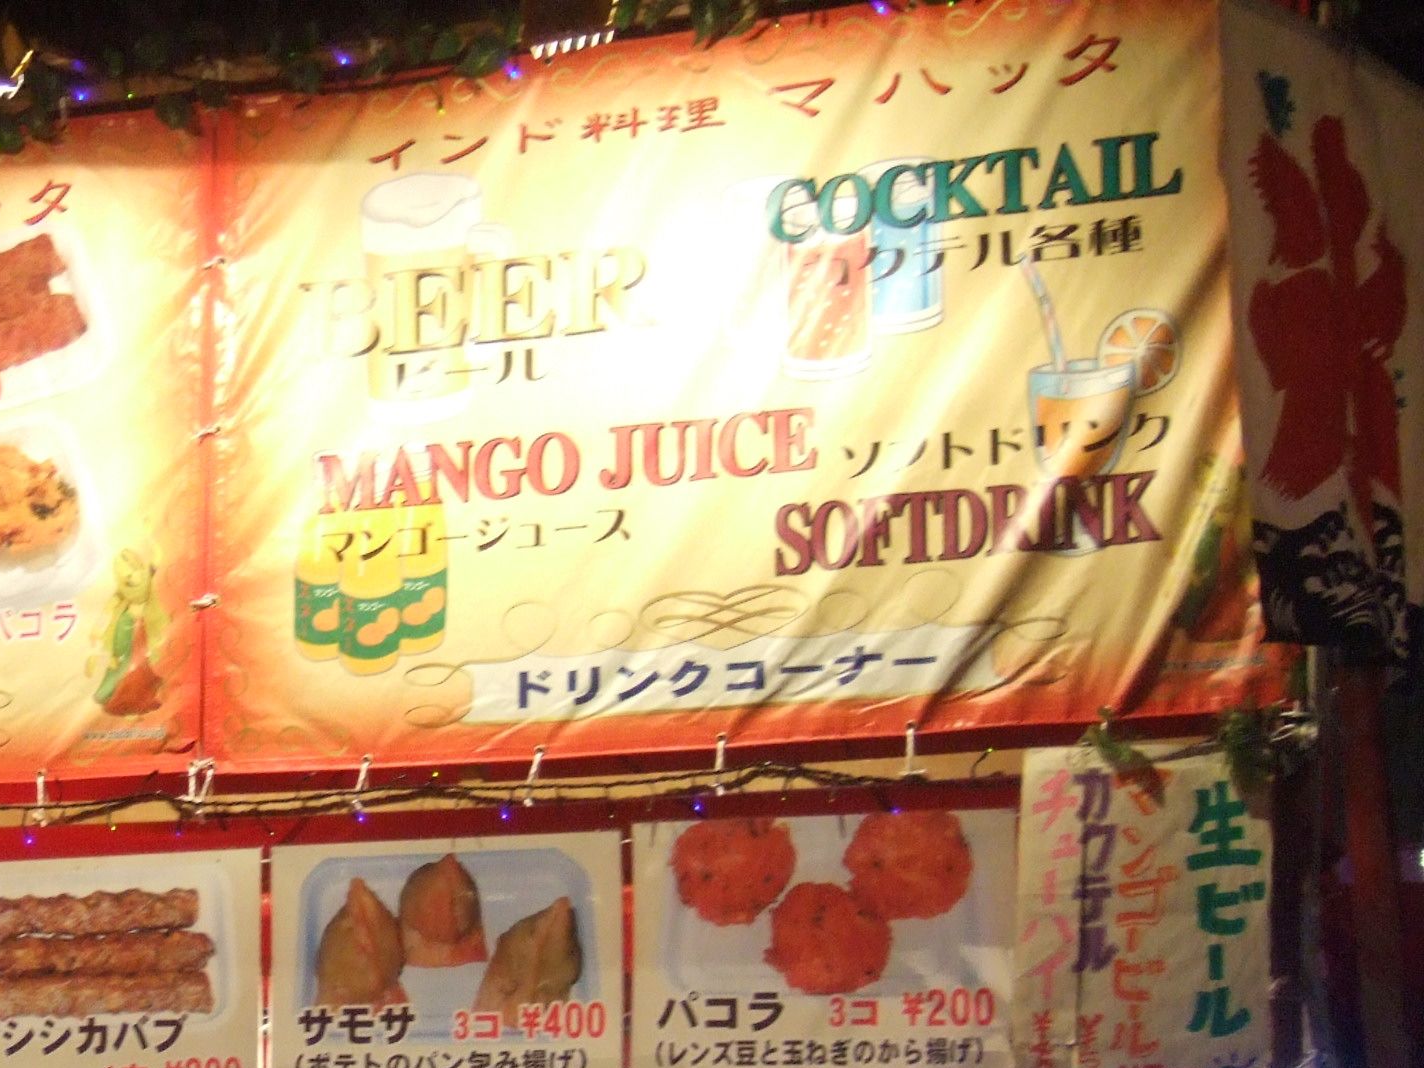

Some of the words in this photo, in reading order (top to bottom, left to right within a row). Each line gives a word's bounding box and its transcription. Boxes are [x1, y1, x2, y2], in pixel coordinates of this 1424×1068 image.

[369, 97, 726, 170] インド料理
[768, 33, 1122, 117] マハッタ
[766, 131, 1184, 244] COCKTAIL
[298, 246, 658, 358] BEER
[396, 348, 550, 393] ビール
[316, 432, 581, 515] MANGO
[600, 407, 818, 490] JUICE
[322, 508, 632, 563] マンゴージュース
[775, 470, 1163, 577] SOFTDRINK
[517, 645, 938, 709] ドリンクコーナー
[1183, 780, 1267, 1040] 生ビール
[1, 1015, 187, 1057] シシカバブ
[297, 1004, 416, 1046] サモサ
[521, 1001, 608, 1040] ¥400
[657, 990, 784, 1032] パコラ
[901, 987, 995, 1027] ¥200
